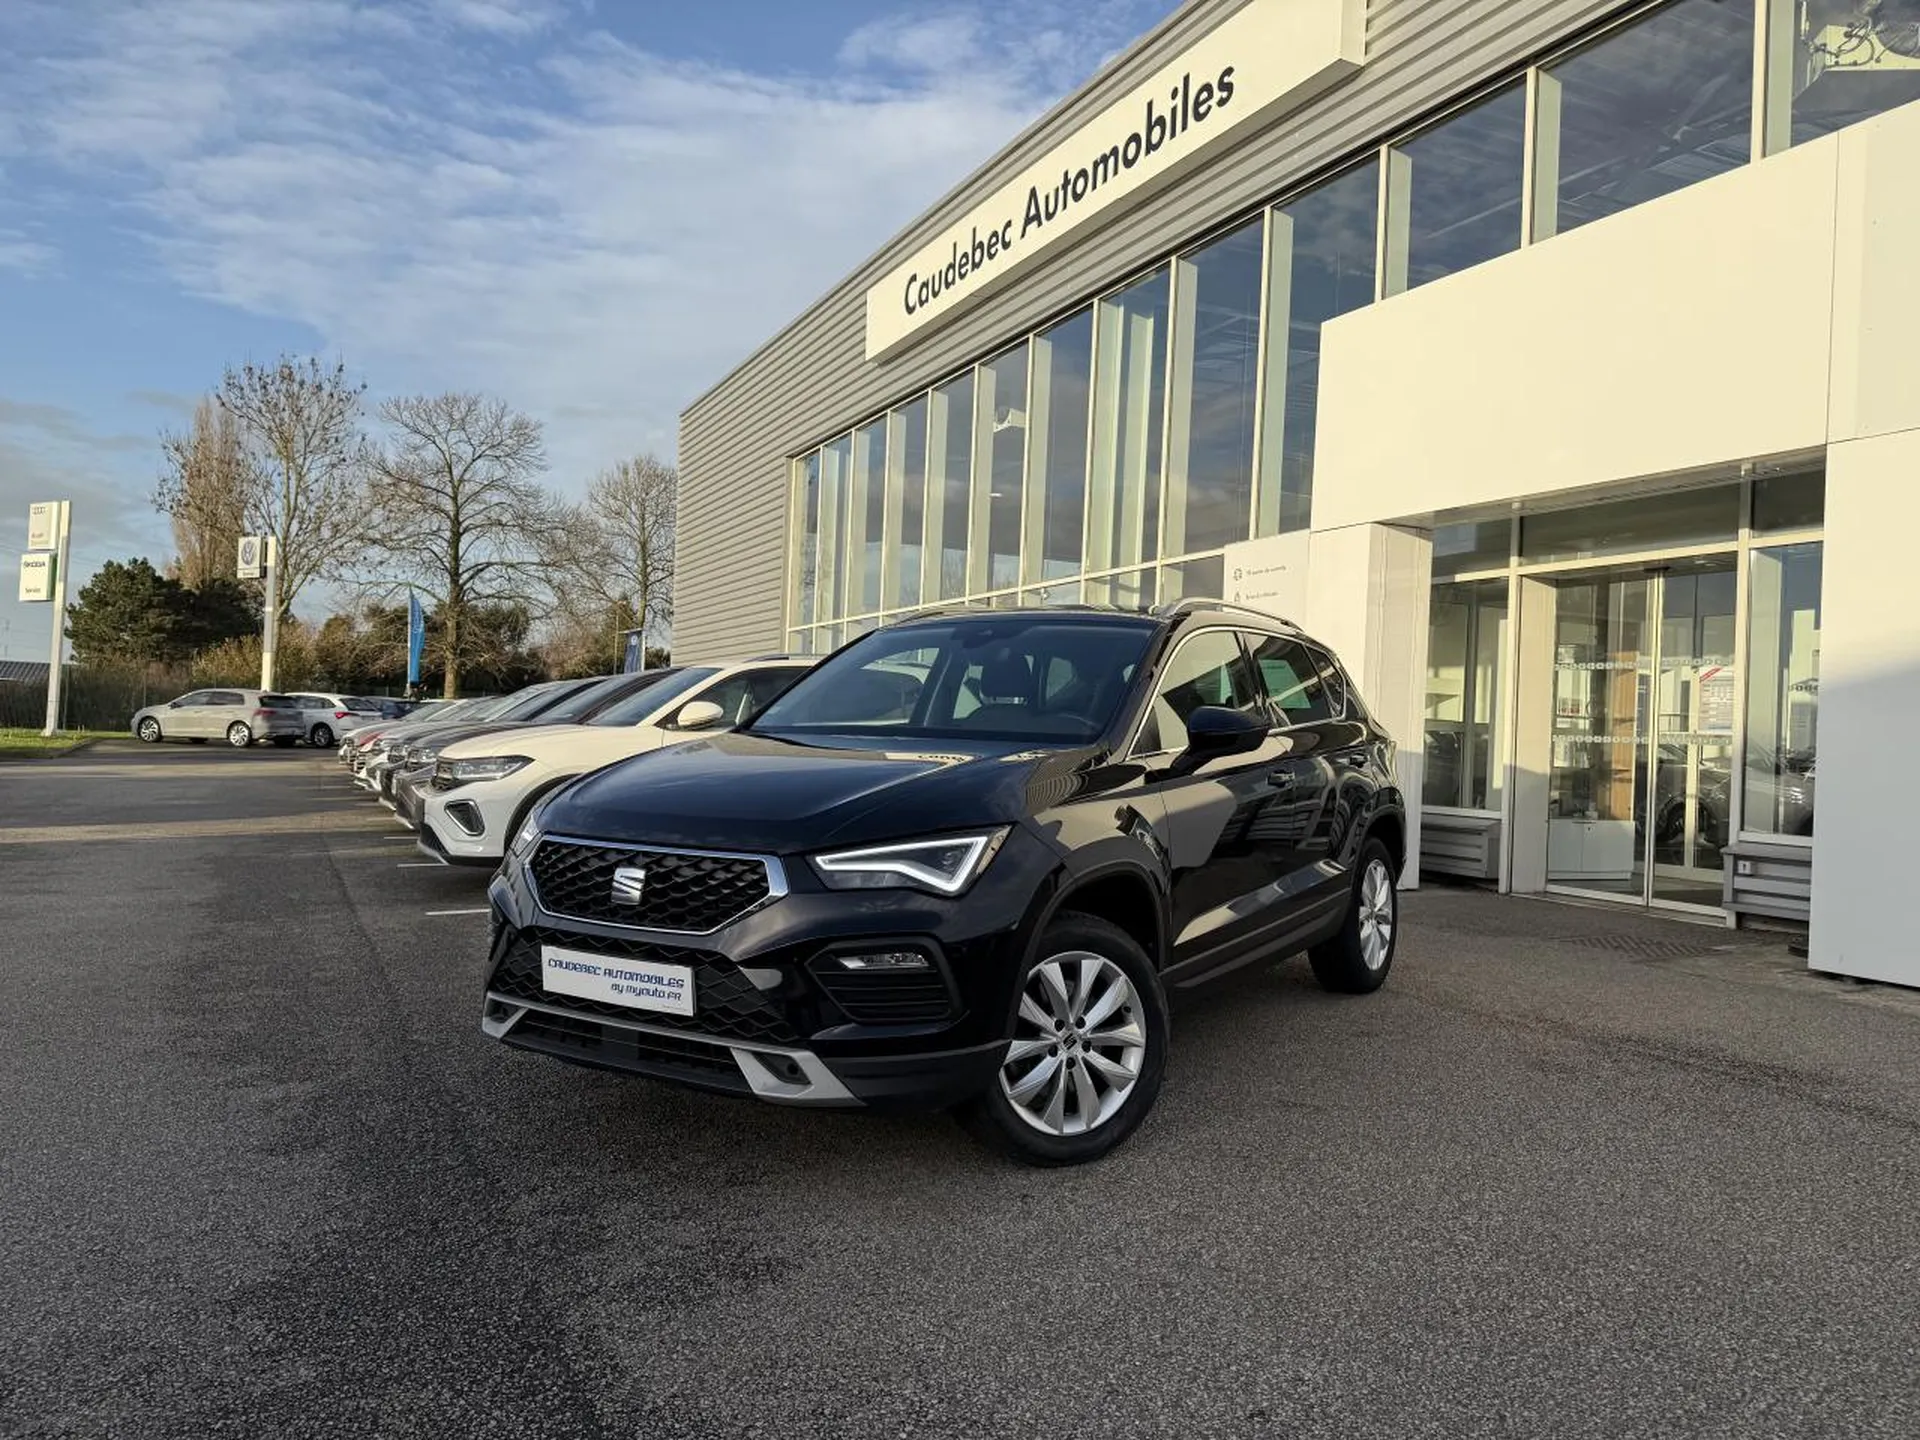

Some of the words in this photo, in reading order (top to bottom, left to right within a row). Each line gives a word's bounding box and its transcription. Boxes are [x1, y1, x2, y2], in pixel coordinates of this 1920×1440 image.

[903, 219, 1012, 316] Caudebec
[1020, 66, 1236, 240] Automobiles
[603, 968, 685, 988] AUTOMOBILES
